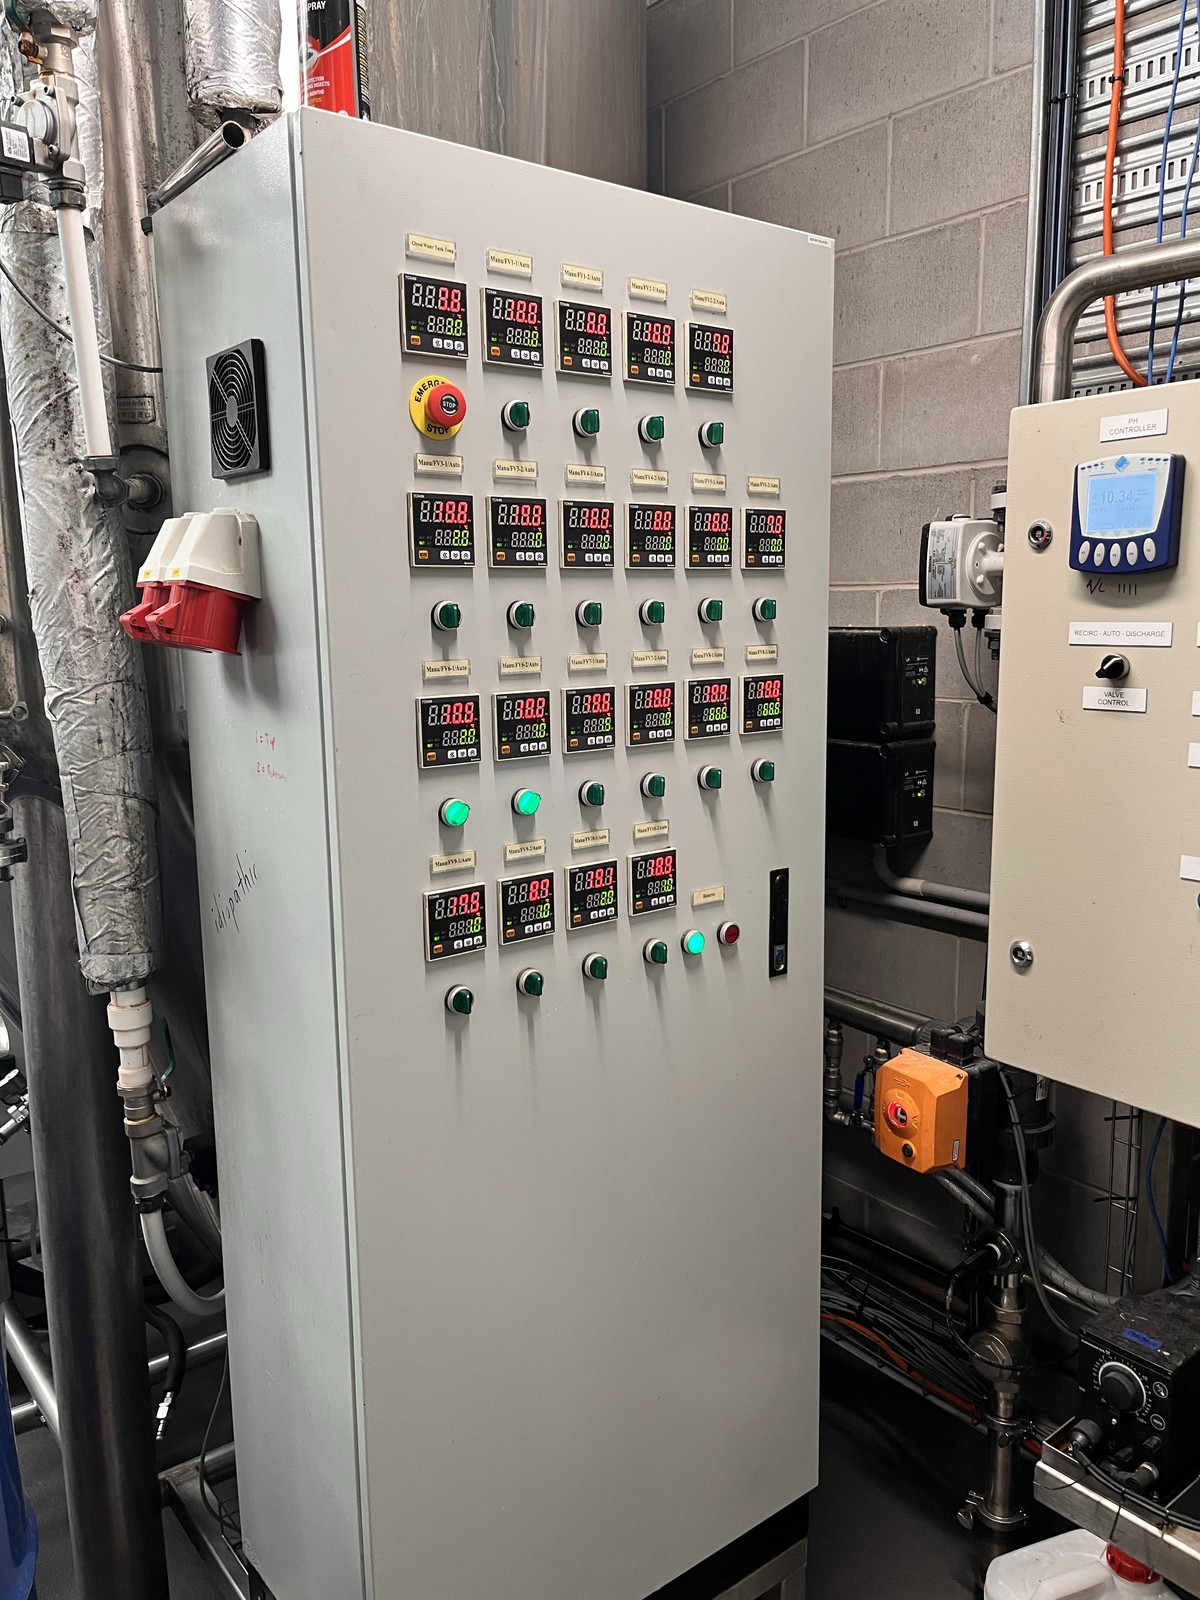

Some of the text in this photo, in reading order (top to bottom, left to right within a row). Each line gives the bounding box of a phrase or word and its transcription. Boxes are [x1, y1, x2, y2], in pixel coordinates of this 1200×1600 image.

[1128, 417, 1139, 425] PH
[1109, 423, 1158, 436] CONTROLLER
[1101, 489, 1134, 505] 10.34
[1125, 630, 1165, 638] DISCHARGE
[1104, 691, 1125, 699] VALVE
[1097, 698, 1130, 707] CONTROL
